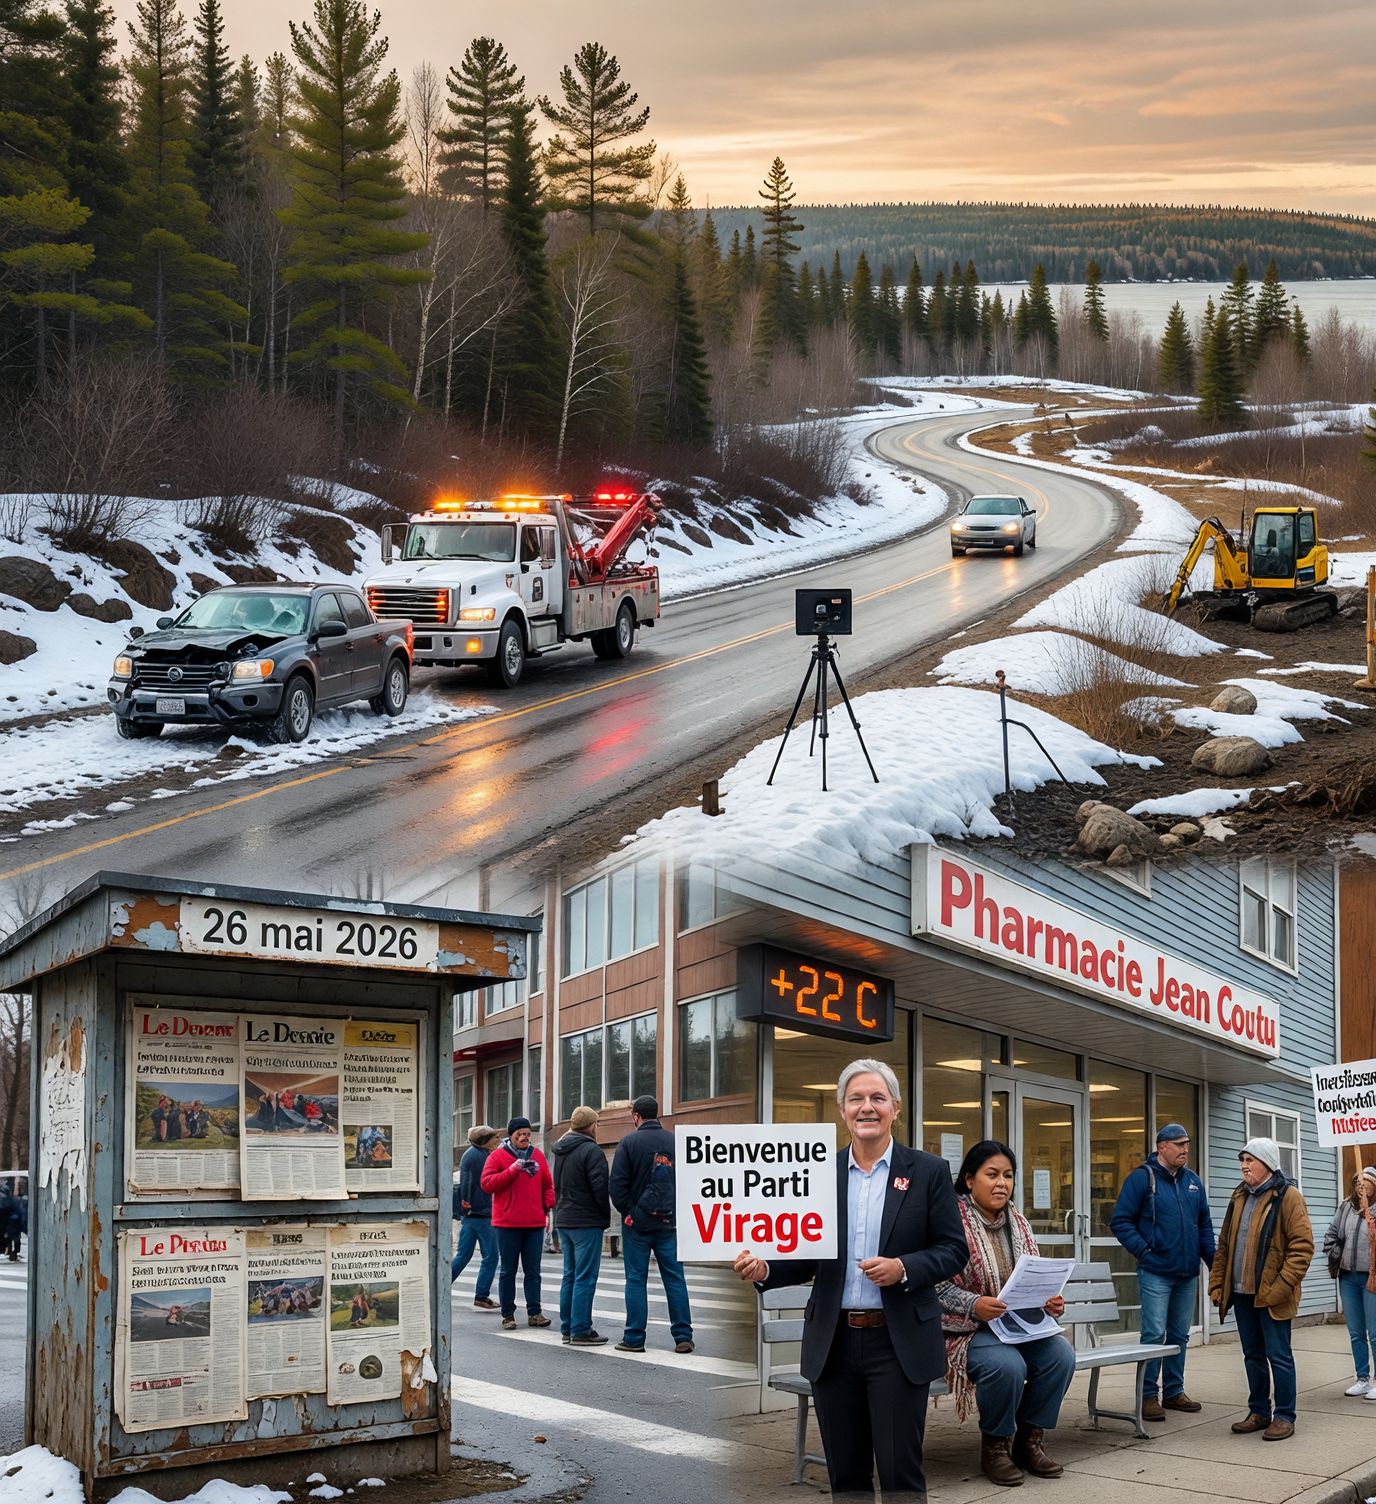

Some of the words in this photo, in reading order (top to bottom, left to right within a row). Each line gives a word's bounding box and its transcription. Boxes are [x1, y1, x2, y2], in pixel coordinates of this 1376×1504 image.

[203, 907, 247, 946] 26
[261, 918, 322, 952] mai
[336, 920, 418, 960] 2026
[941, 859, 1143, 998] Pharmacie
[1150, 957, 1210, 1024] Jean
[1217, 985, 1276, 1048] Coutu
[771, 965, 844, 1021] +22
[856, 981, 878, 1029] C
[245, 1020, 270, 1042] Le
[686, 1135, 827, 1164] Bienvenue
[701, 1178, 733, 1198] au
[744, 1168, 809, 1197] Parti
[140, 1236, 164, 1256] Le
[691, 1202, 823, 1253] Virage
